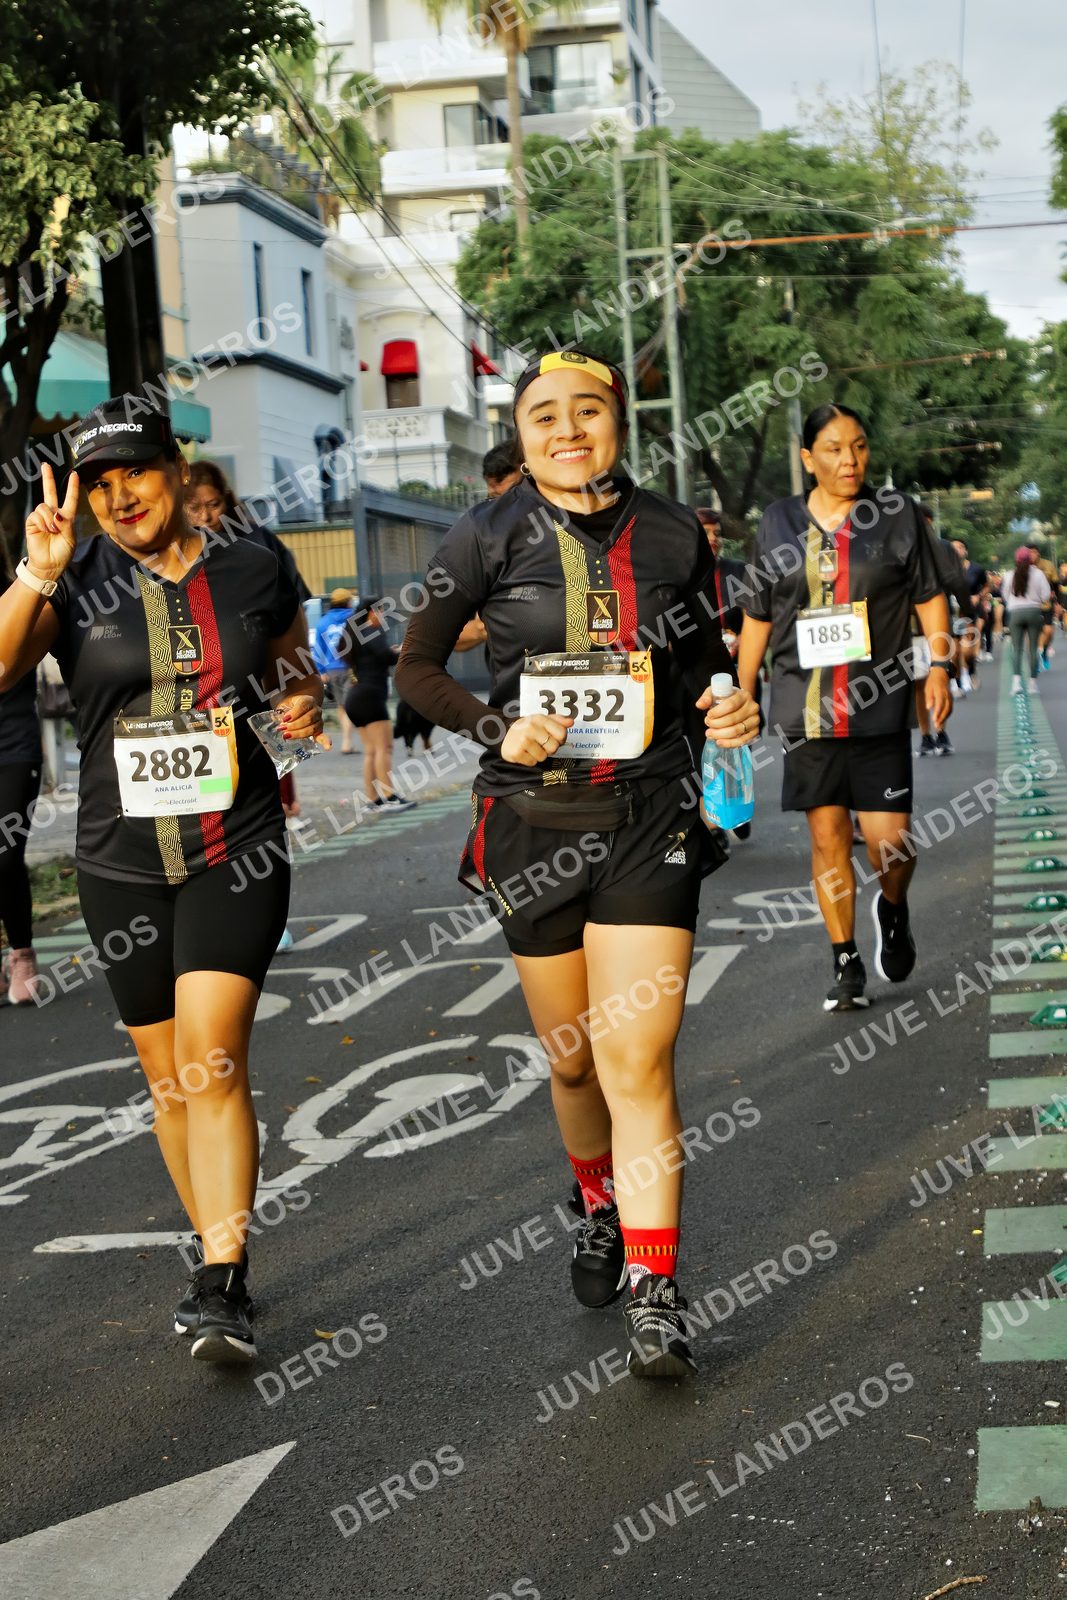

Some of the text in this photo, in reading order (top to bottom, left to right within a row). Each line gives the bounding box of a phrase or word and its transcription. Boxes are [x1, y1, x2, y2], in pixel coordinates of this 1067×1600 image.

[99, 423, 143, 435] NEGROS
[807, 623, 852, 645] 1885
[631, 661, 648, 673] 5K
[538, 688, 625, 722] 3332
[214, 716, 229, 728] 5K
[129, 744, 213, 782] 2882
[170, 784, 193, 792] ALICIA
